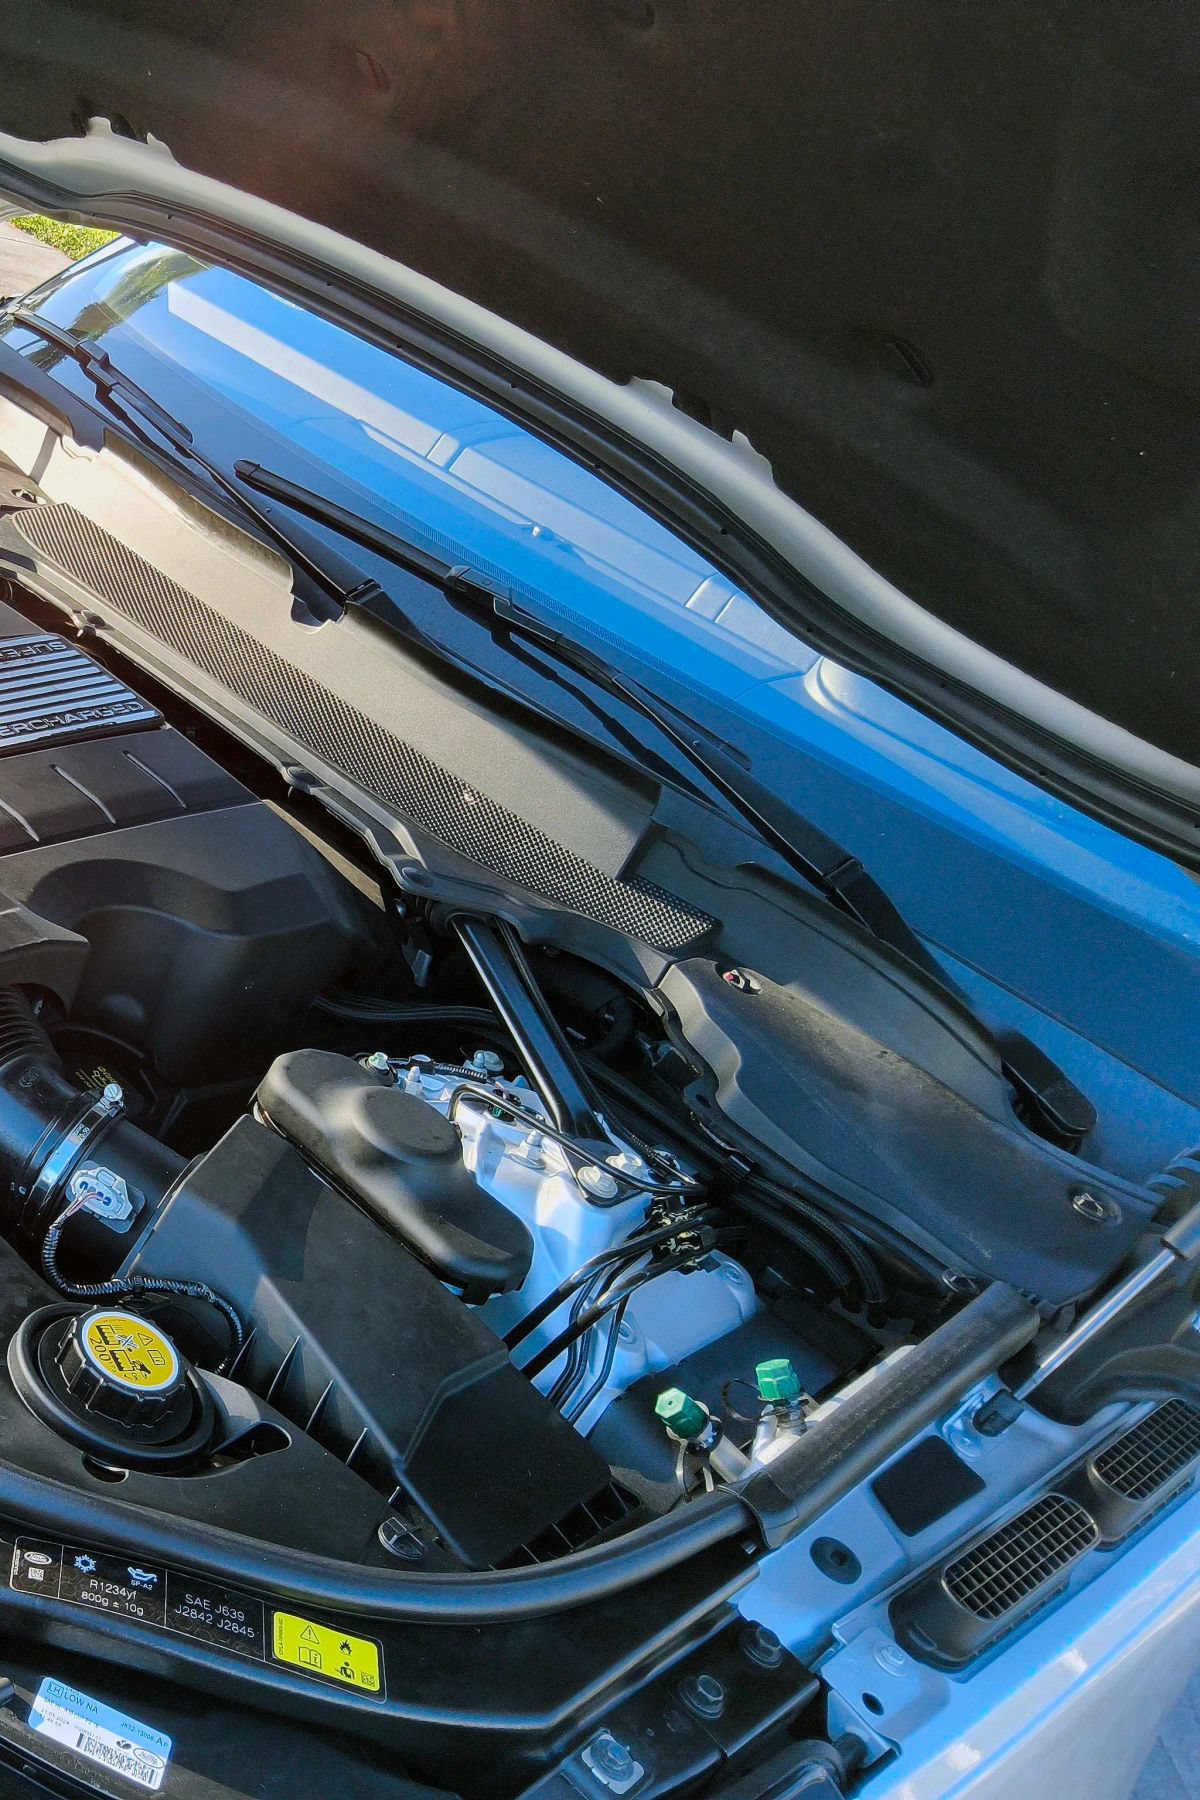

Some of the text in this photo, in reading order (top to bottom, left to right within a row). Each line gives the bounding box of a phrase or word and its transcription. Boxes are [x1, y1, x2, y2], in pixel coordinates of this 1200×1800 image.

[89, 1337, 111, 1362] 200
[89, 1579, 137, 1600] R1234yf
[130, 1579, 153, 1591] SP-A2
[81, 1591, 109, 1607] 800g
[124, 1602, 144, 1617] 10g
[185, 1593, 245, 1622] SAE J639
[175, 1604, 213, 1625] J2842
[216, 1618, 255, 1638] J2845
[49, 1683, 62, 1697] LH
[63, 1691, 85, 1706] LOW
[86, 1702, 99, 1714] NA
